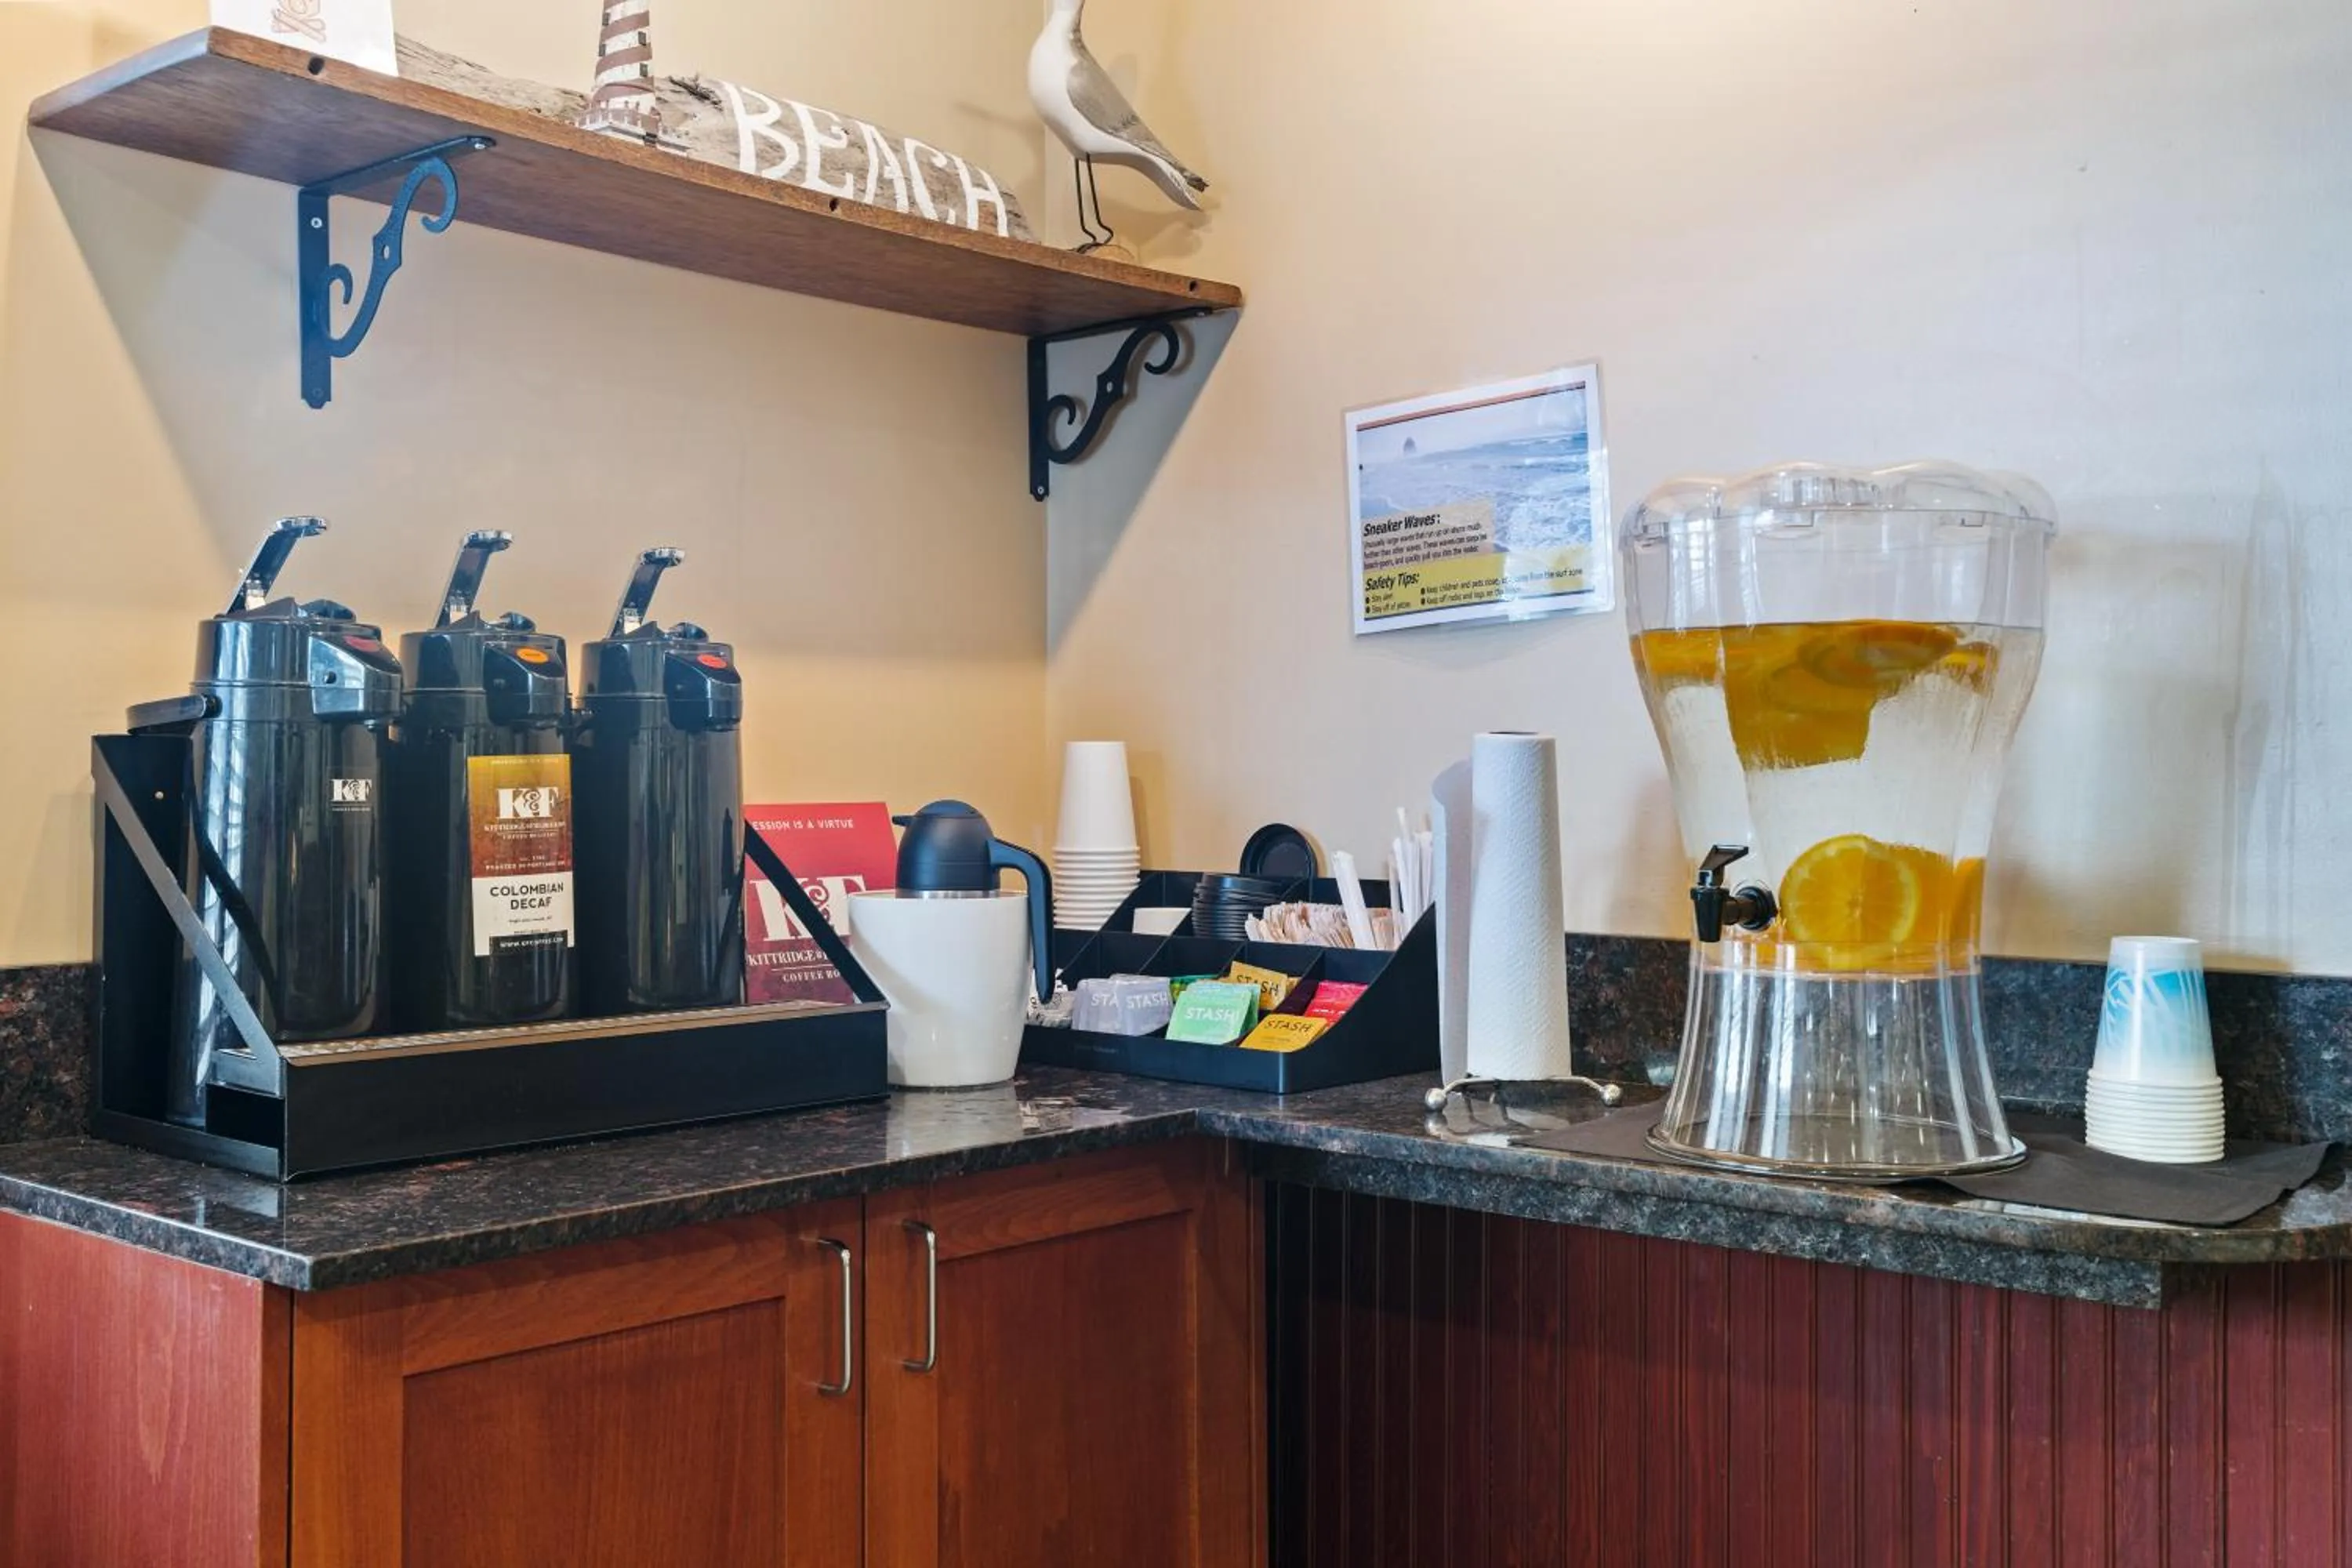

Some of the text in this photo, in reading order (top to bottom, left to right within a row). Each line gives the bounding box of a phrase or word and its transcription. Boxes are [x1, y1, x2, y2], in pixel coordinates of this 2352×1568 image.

[720, 80, 1009, 237] BEACH
[1363, 518, 1403, 536] Sneaker
[1366, 572, 1420, 591] Safety Tips:
[330, 779, 373, 802] K&F
[495, 786, 559, 819] K&F
[752, 818, 854, 830] ESSION IS A VIRTUE
[490, 881, 564, 897] COLOMBIAN
[510, 896, 552, 910] DECAF
[747, 949, 816, 967] KITTRIDGE
[782, 970, 824, 983] COFFEE
[1236, 975, 1280, 996] STSH
[1091, 993, 1119, 1007] STA
[1125, 992, 1169, 1009] STASH
[1185, 1007, 1239, 1021] STASH
[1263, 1019, 1312, 1033] STASH
